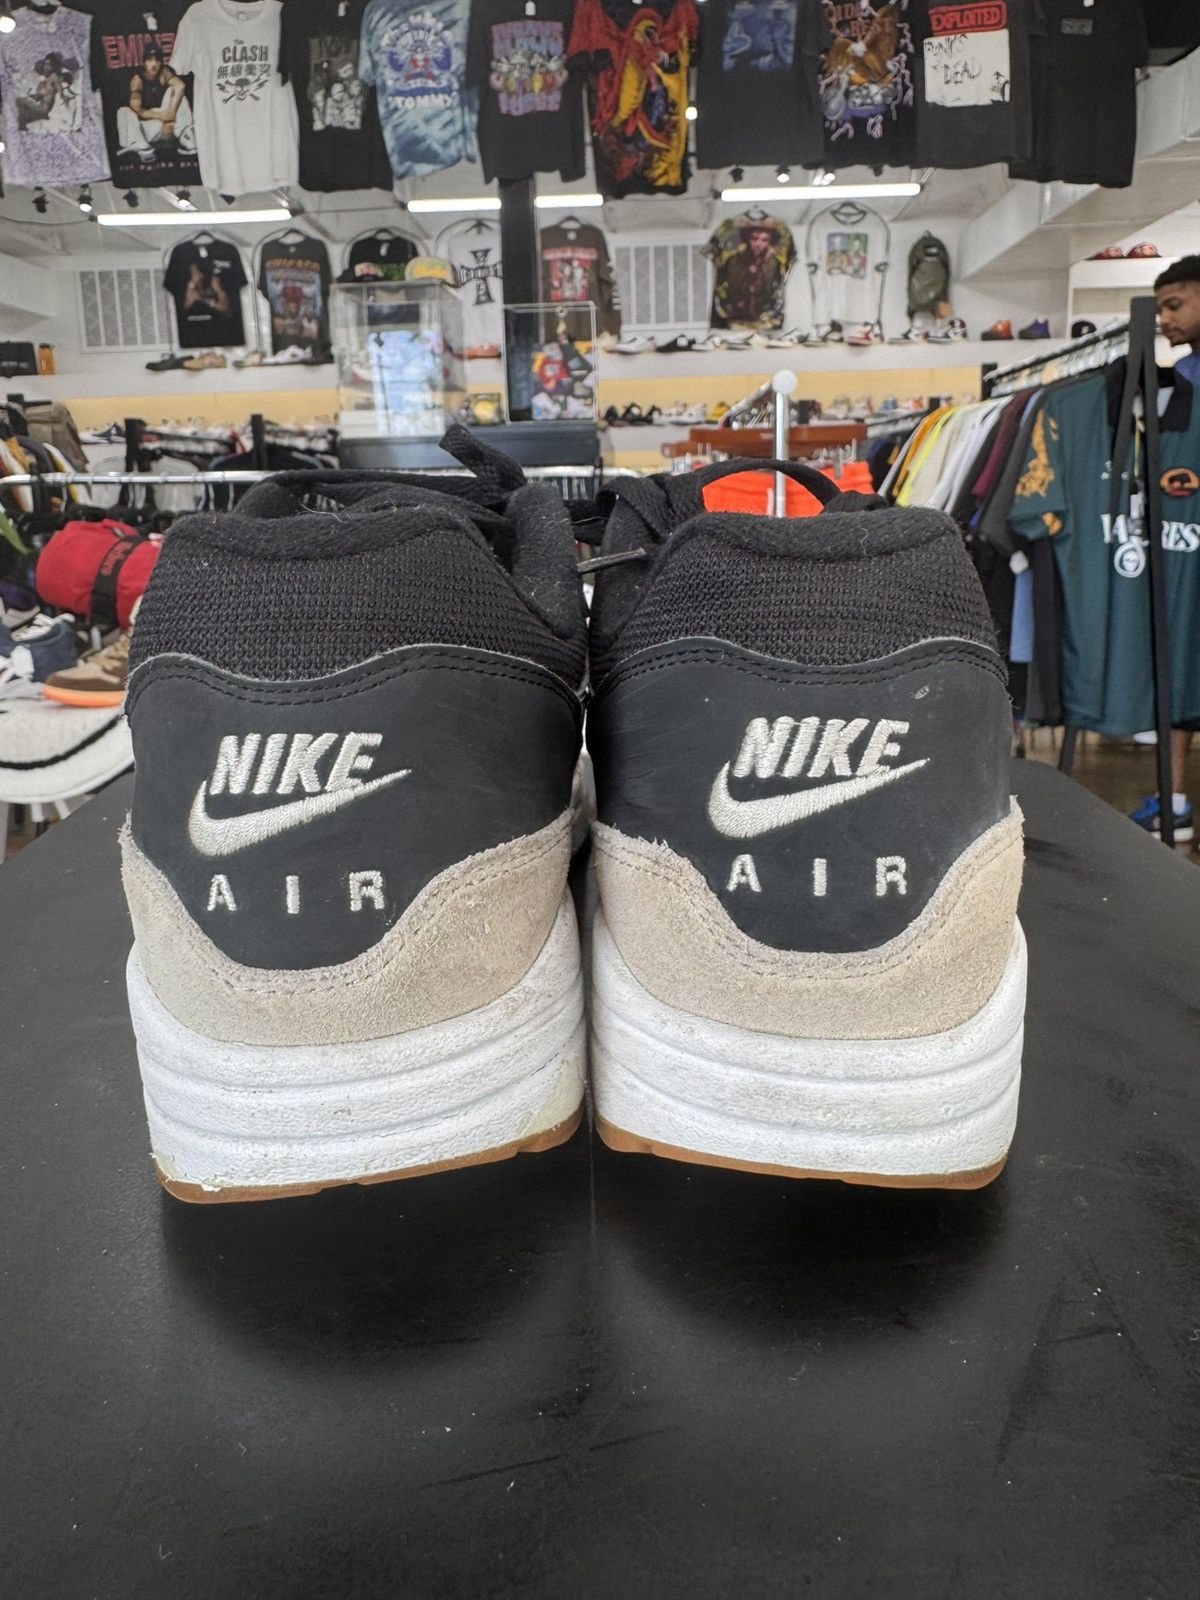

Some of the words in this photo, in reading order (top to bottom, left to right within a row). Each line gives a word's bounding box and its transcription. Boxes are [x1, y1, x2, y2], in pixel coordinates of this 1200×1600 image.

[931, 6, 1002, 31] EXPLOITED
[102, 32, 176, 69] EMIE
[222, 45, 269, 63] CLASH
[209, 731, 384, 796] NIKE
[732, 715, 910, 779] NIKE
[206, 870, 386, 915] AIR
[726, 853, 908, 897] AIR
